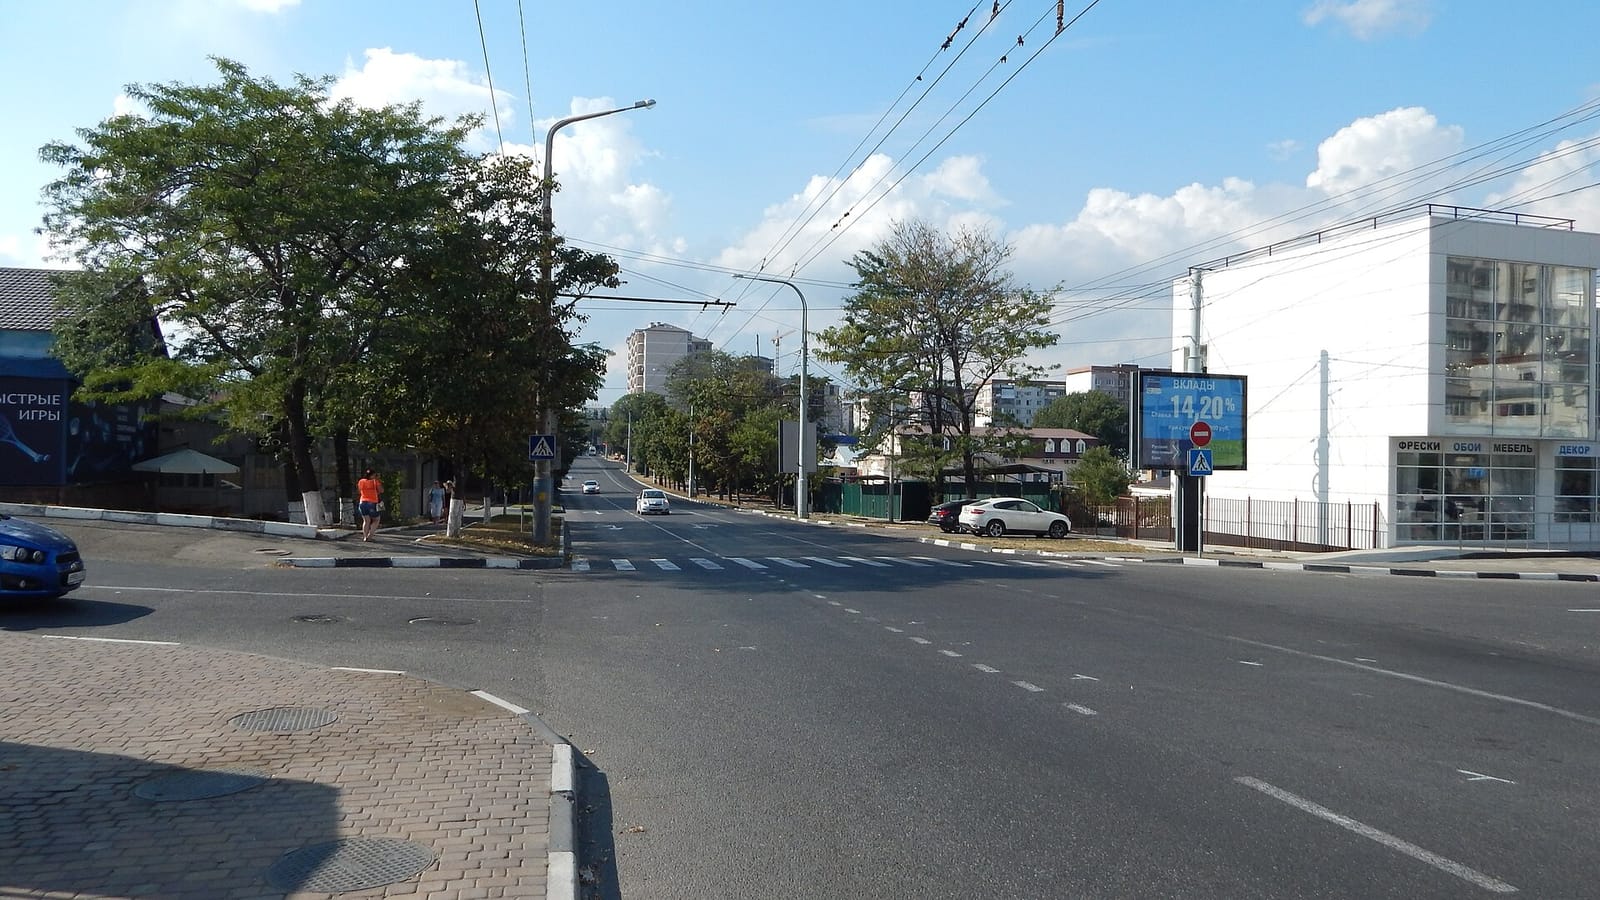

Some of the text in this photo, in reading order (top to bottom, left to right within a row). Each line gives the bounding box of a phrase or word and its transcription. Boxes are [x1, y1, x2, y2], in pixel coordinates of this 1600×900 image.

[1173, 379, 1215, 391] ВКЛАДЫ
[19, 409, 60, 421] ИГРЫ
[1398, 441, 1441, 452] ФРЕСКИ
[1453, 442, 1481, 452] ОБОИ
[1493, 443, 1533, 453] МЕБЕЛЬ
[1559, 445, 1590, 455] ДЕКОР
